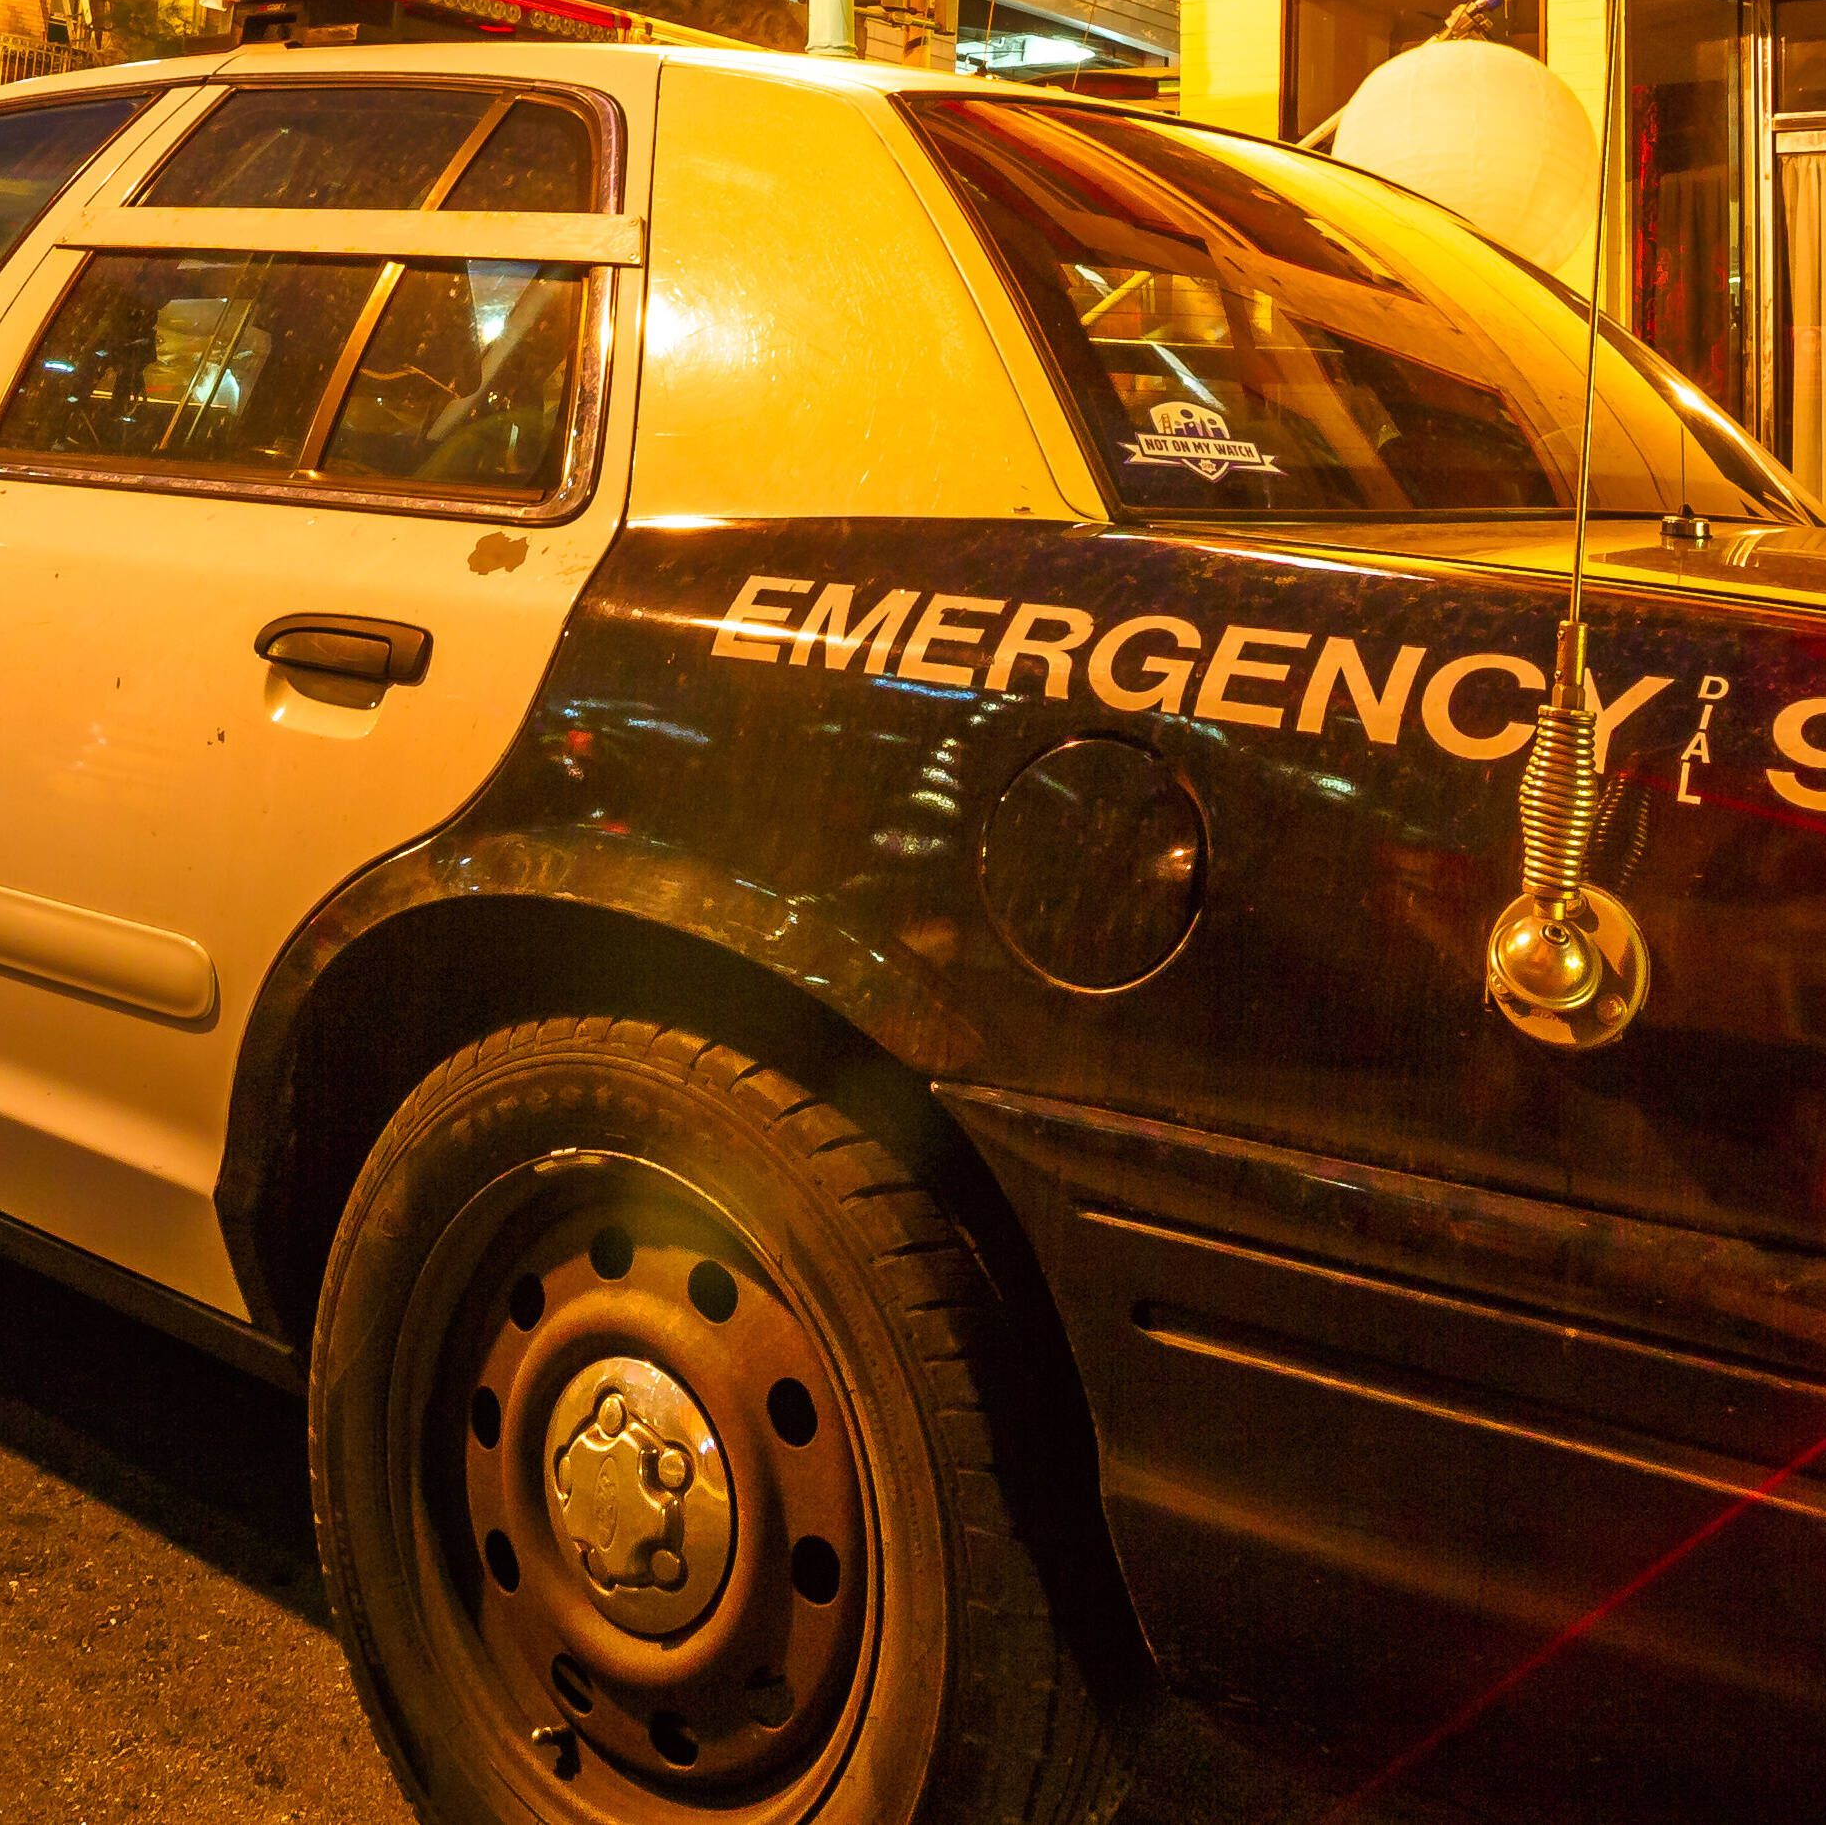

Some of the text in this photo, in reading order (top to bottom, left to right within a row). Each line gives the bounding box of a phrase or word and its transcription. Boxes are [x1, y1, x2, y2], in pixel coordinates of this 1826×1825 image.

[1144, 437, 1255, 459] NOT ON MY WATCH
[710, 574, 1673, 776] EMERGENCY
[1676, 674, 1729, 808] DIAL
